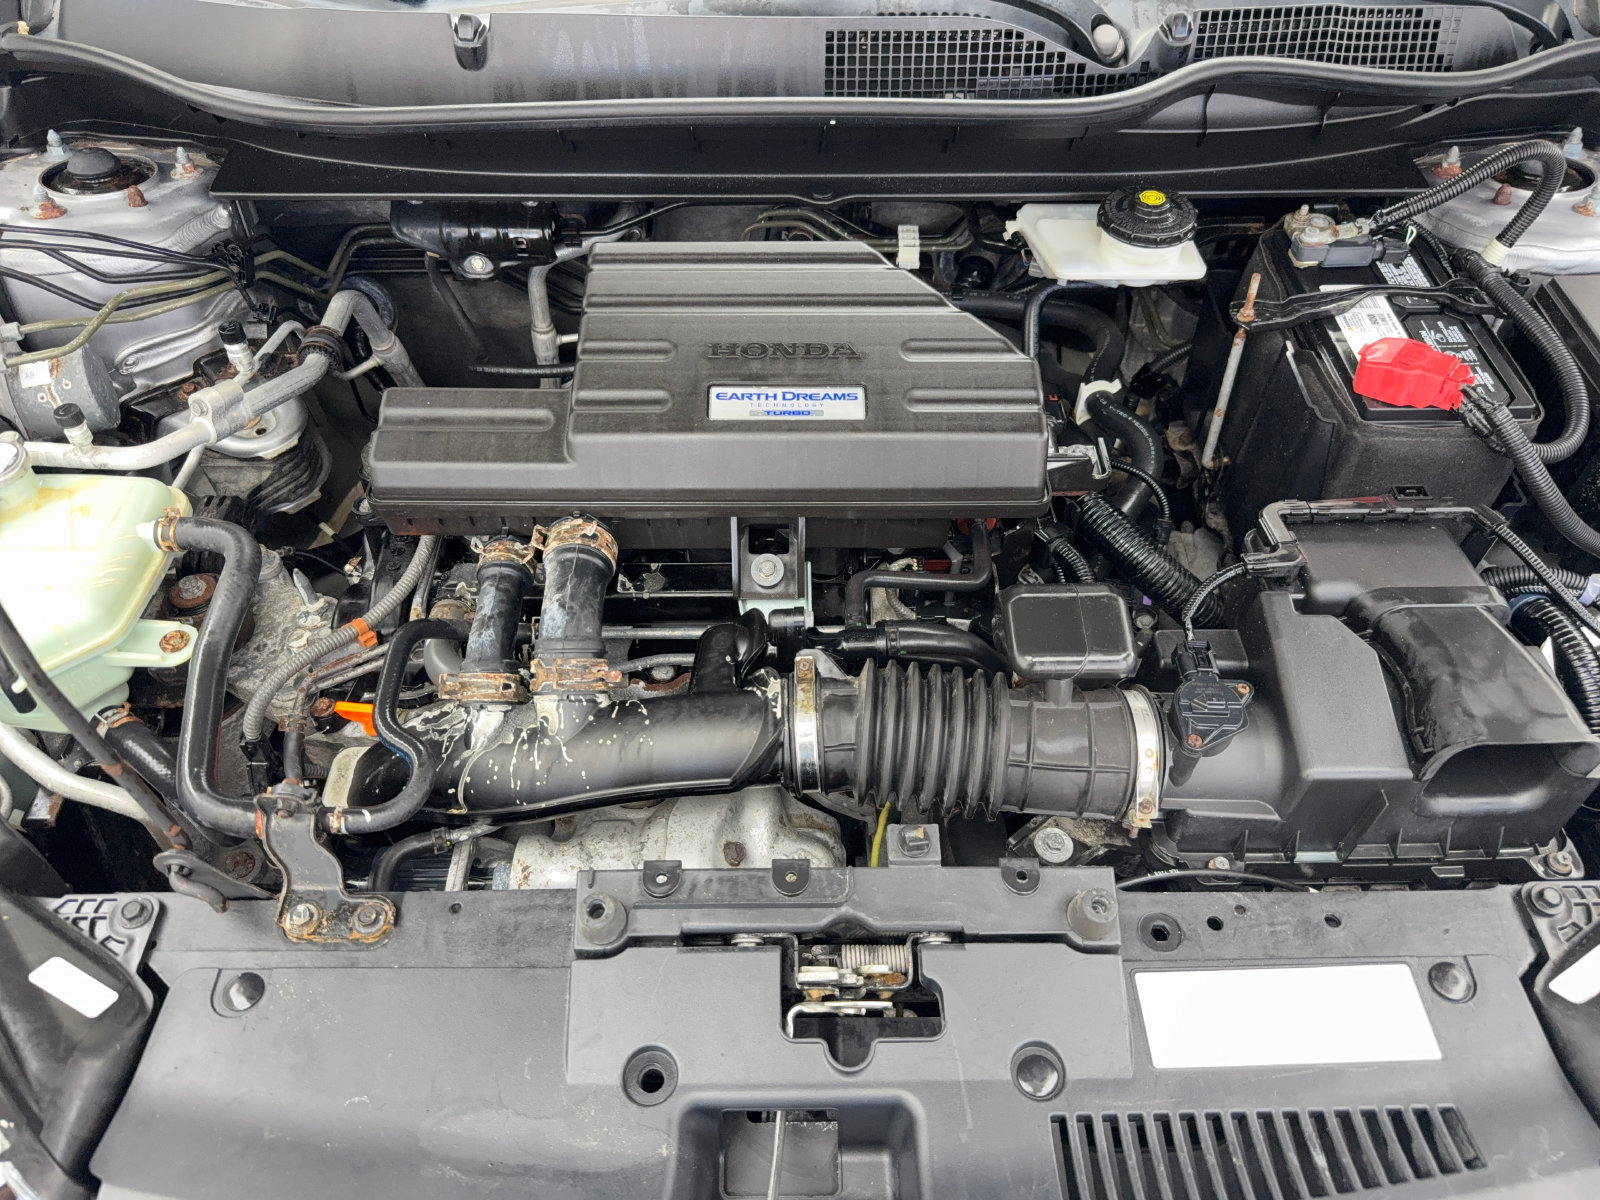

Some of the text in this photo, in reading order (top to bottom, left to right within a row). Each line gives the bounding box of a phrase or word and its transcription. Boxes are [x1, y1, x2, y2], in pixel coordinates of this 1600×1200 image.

[707, 342, 861, 359] HONDA
[715, 391, 859, 401] EARTH DREAMS
